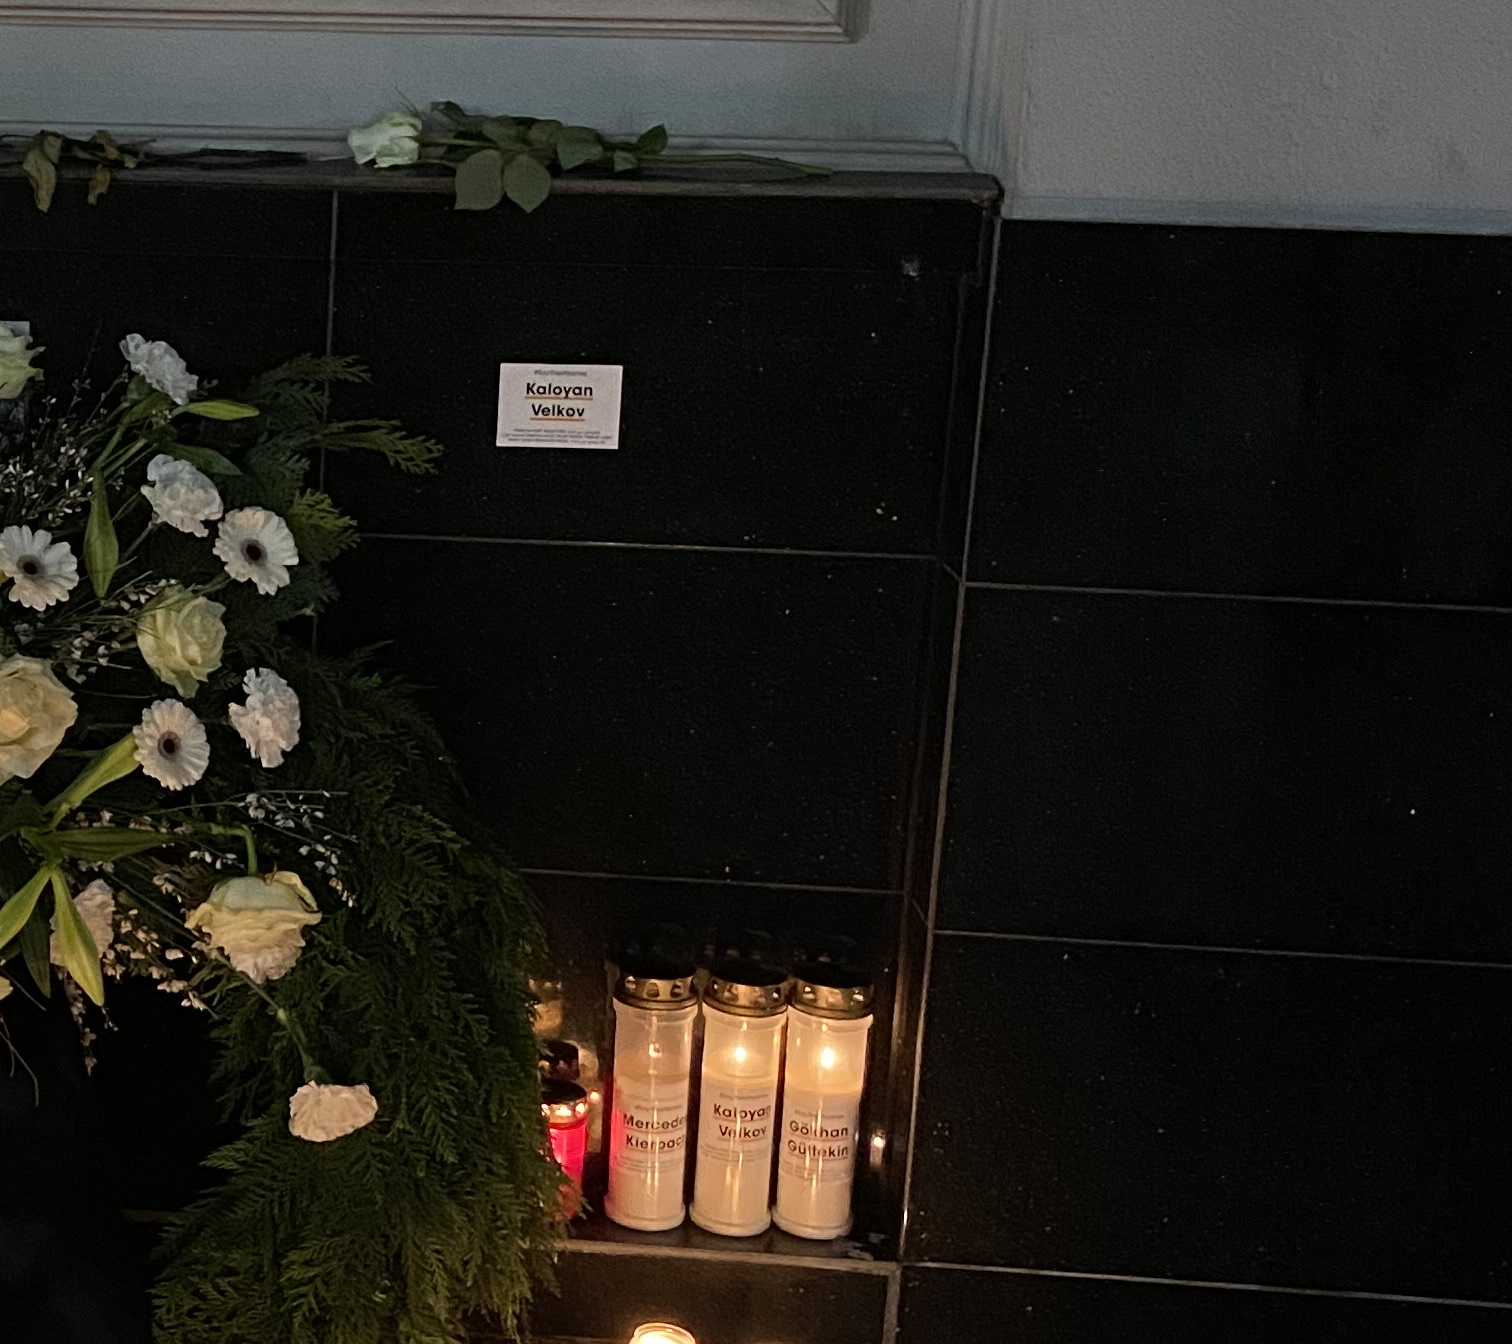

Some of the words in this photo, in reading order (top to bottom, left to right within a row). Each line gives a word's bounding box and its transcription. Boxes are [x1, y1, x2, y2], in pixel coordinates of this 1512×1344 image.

[526, 382, 594, 399] Kaloyan
[531, 403, 586, 418] Velkov
[623, 1113, 687, 1131] Mercede
